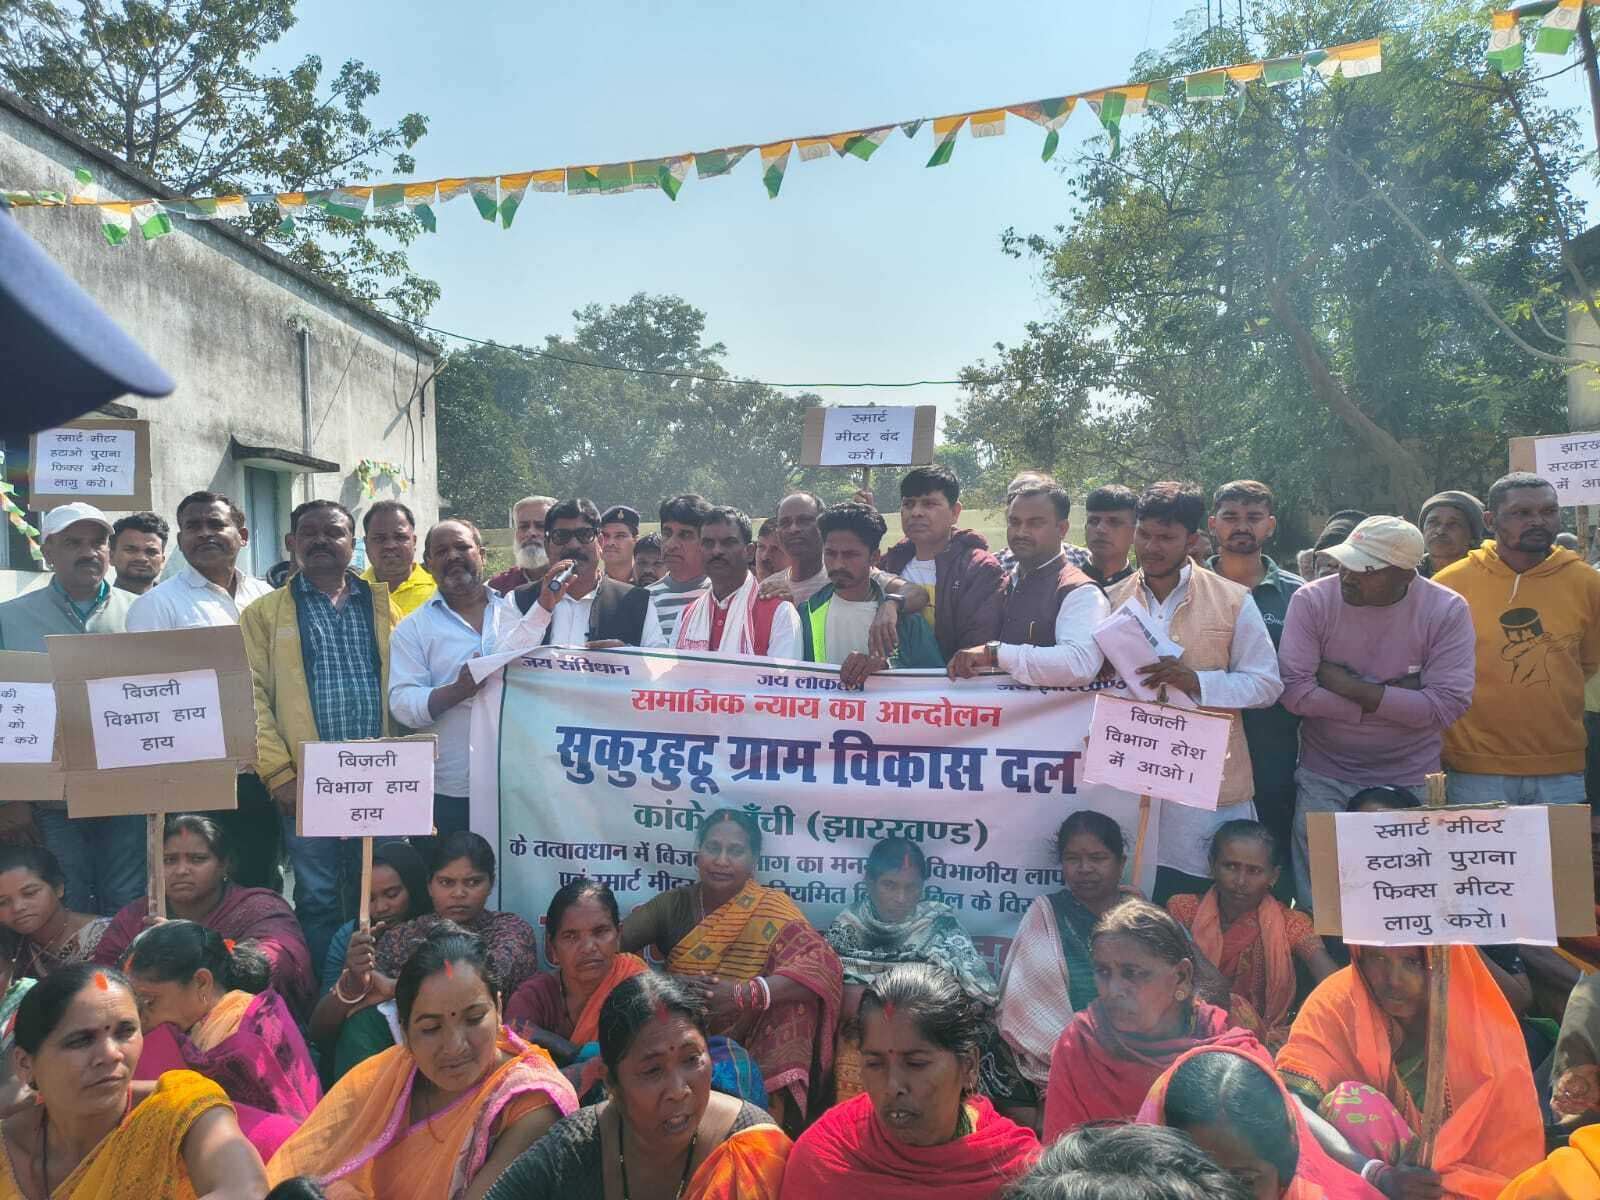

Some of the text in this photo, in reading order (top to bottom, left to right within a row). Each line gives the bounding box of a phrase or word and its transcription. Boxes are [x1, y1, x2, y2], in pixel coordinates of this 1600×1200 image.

[852, 409, 888, 423] स्मार्ट
[56, 432, 118, 443] स्मार्ट मीटर
[834, 429, 900, 442] मीटर बंद
[50, 448, 121, 460] हटाओ पुराना
[51, 461, 118, 472] फिक्स मीटर
[521, 656, 631, 675] जय संविधान
[122, 679, 181, 700] बिजली
[756, 674, 789, 688] जय
[104, 706, 207, 727] विभाग हाय
[631, 687, 1003, 728] समाजिक न्याय का आन्दोलन
[1131, 706, 1188, 731] बिजली
[14, 734, 38, 744] करो
[140, 735, 175, 752] हाय
[1105, 725, 1207, 761] विभाग होश
[338, 750, 398, 768] बिजली
[556, 725, 1082, 795] सुकुरहुटू ग्राम विकास दल
[1109, 751, 1125, 767] में
[316, 777, 420, 795] विभाग हाय
[350, 807, 384, 821] हाय
[1374, 815, 1505, 840] स्मार्ट मीटर
[509, 834, 527, 857] के
[534, 840, 628, 861] तत्वावधान
[633, 841, 653, 862] में
[796, 856, 824, 874] का
[1365, 847, 1517, 872] हटाओ पुराना
[926, 856, 1018, 884] विभागीय
[1372, 876, 1515, 900] फिक्स मीटर
[970, 890, 992, 912] के
[1383, 914, 1434, 935] लागु
